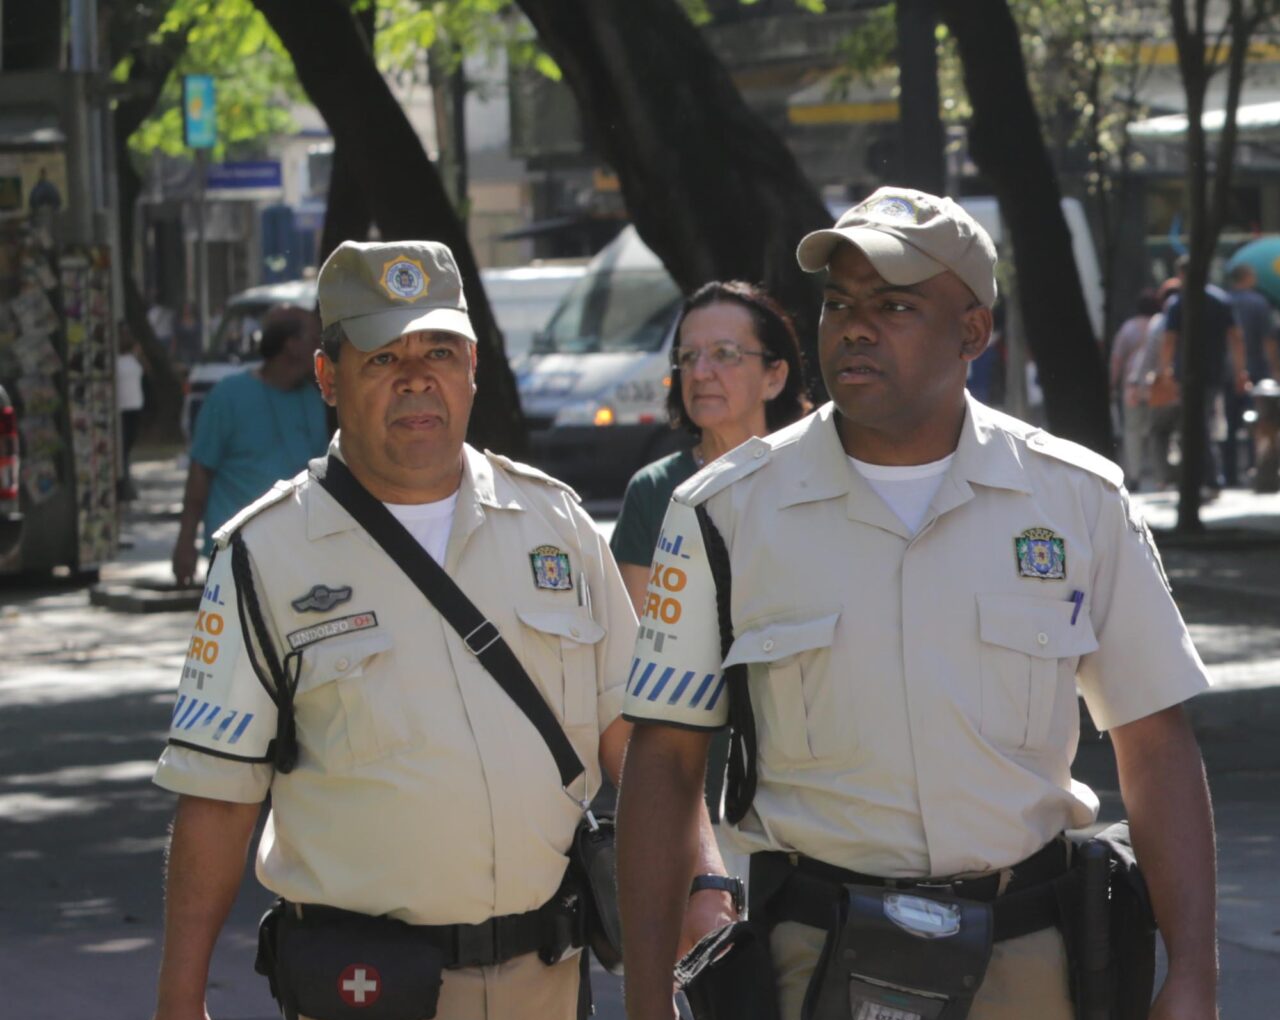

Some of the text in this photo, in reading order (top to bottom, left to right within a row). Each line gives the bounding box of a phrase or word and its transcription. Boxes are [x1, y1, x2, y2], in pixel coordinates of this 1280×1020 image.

[650, 561, 688, 592] XO
[643, 591, 683, 624] RO
[194, 610, 225, 636] XO
[291, 620, 349, 648] LINDOLFO
[187, 636, 219, 665] RO
